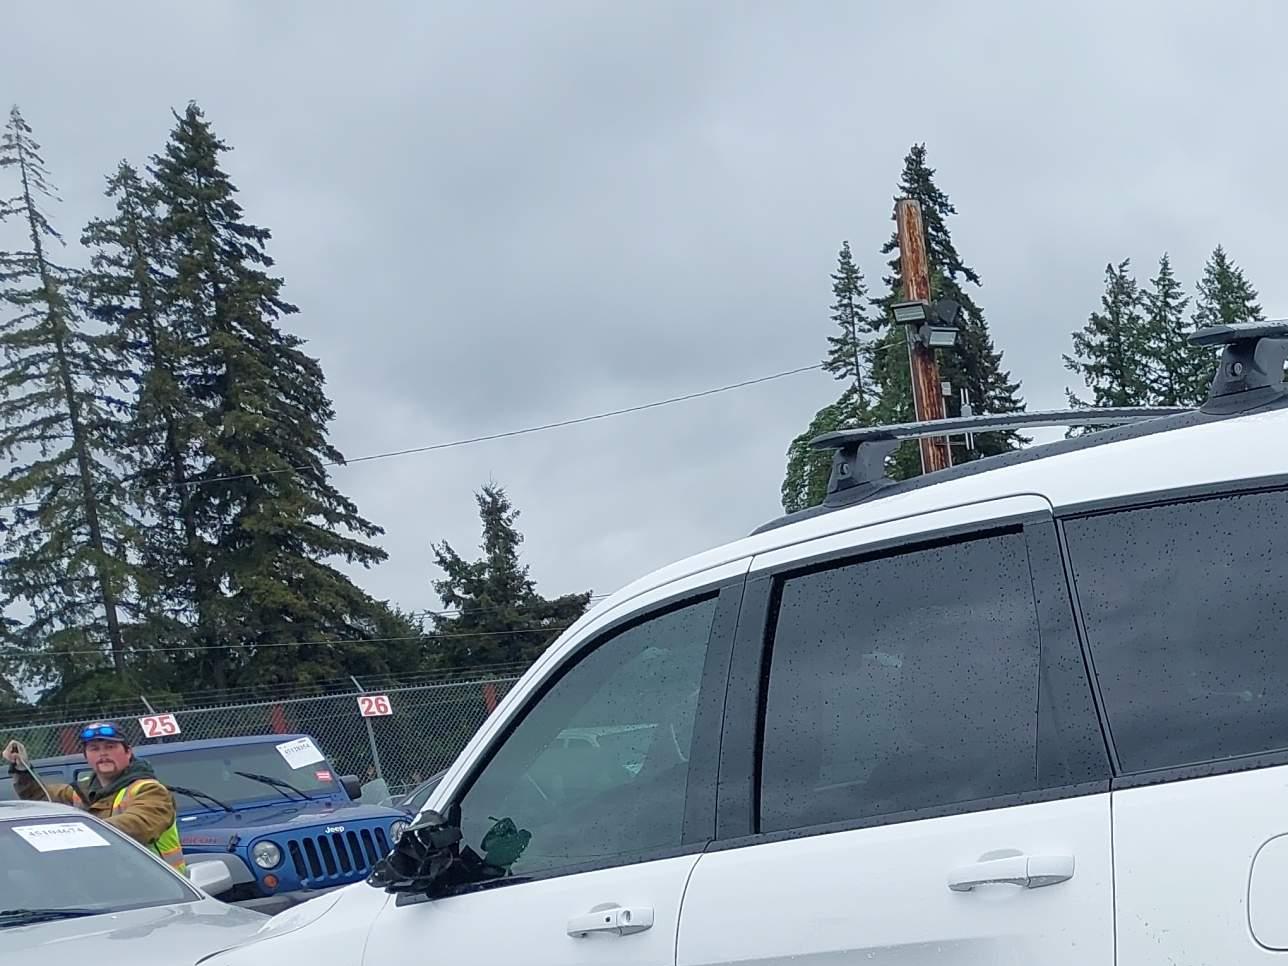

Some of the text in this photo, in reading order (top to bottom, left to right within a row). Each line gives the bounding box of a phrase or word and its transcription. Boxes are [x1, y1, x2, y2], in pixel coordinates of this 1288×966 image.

[361, 696, 389, 716] 26
[143, 715, 177, 737] 25
[325, 826, 345, 834] Jeep
